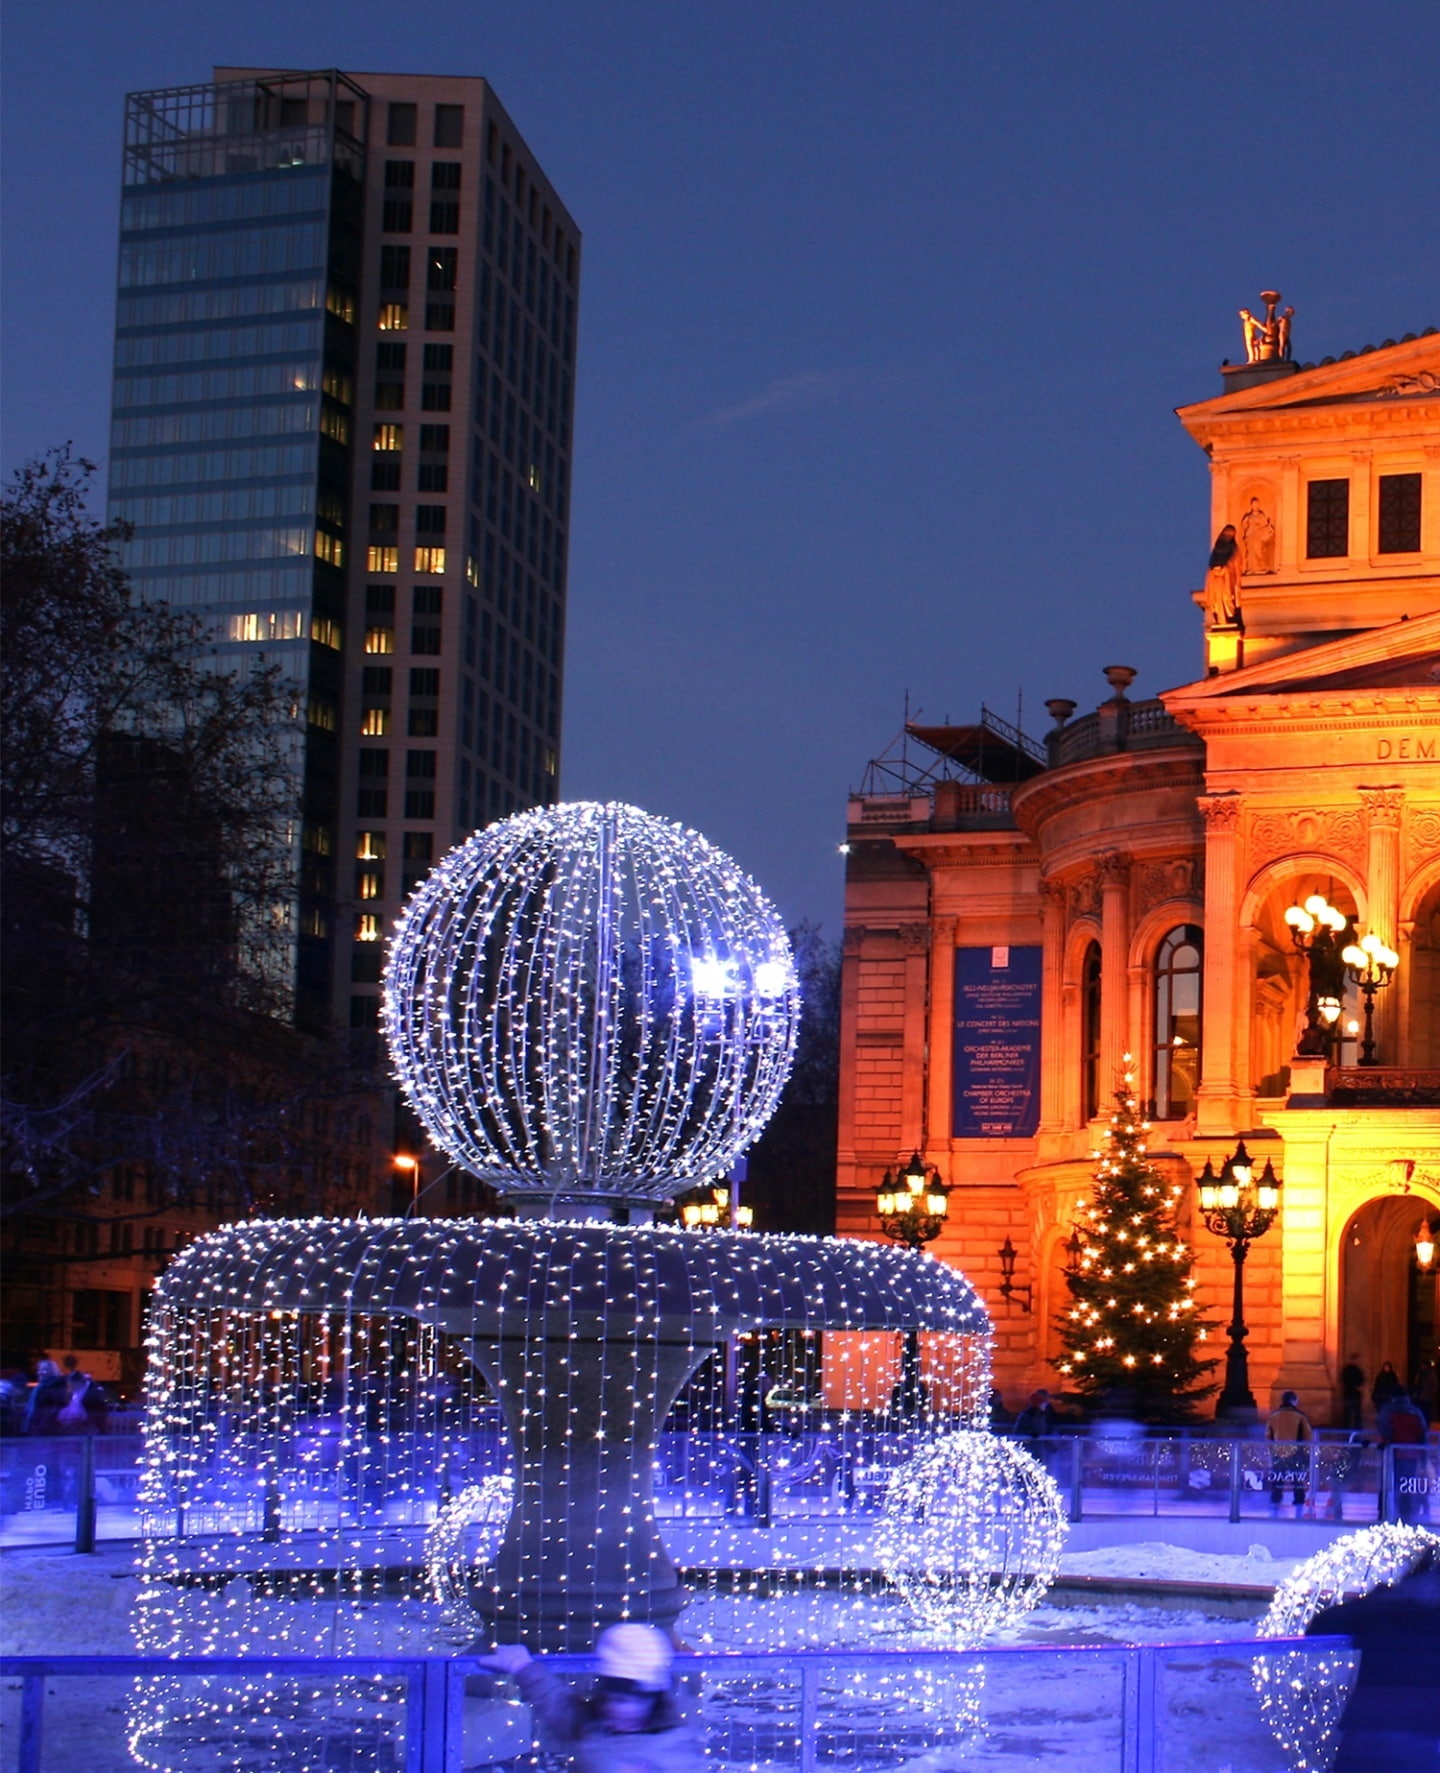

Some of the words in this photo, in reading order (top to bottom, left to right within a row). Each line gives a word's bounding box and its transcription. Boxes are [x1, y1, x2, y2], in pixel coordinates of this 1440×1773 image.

[1376, 737, 1437, 760] DEM
[966, 1020, 997, 1028] CONCERT
[994, 1089, 1032, 1097] ORCHESTRA
